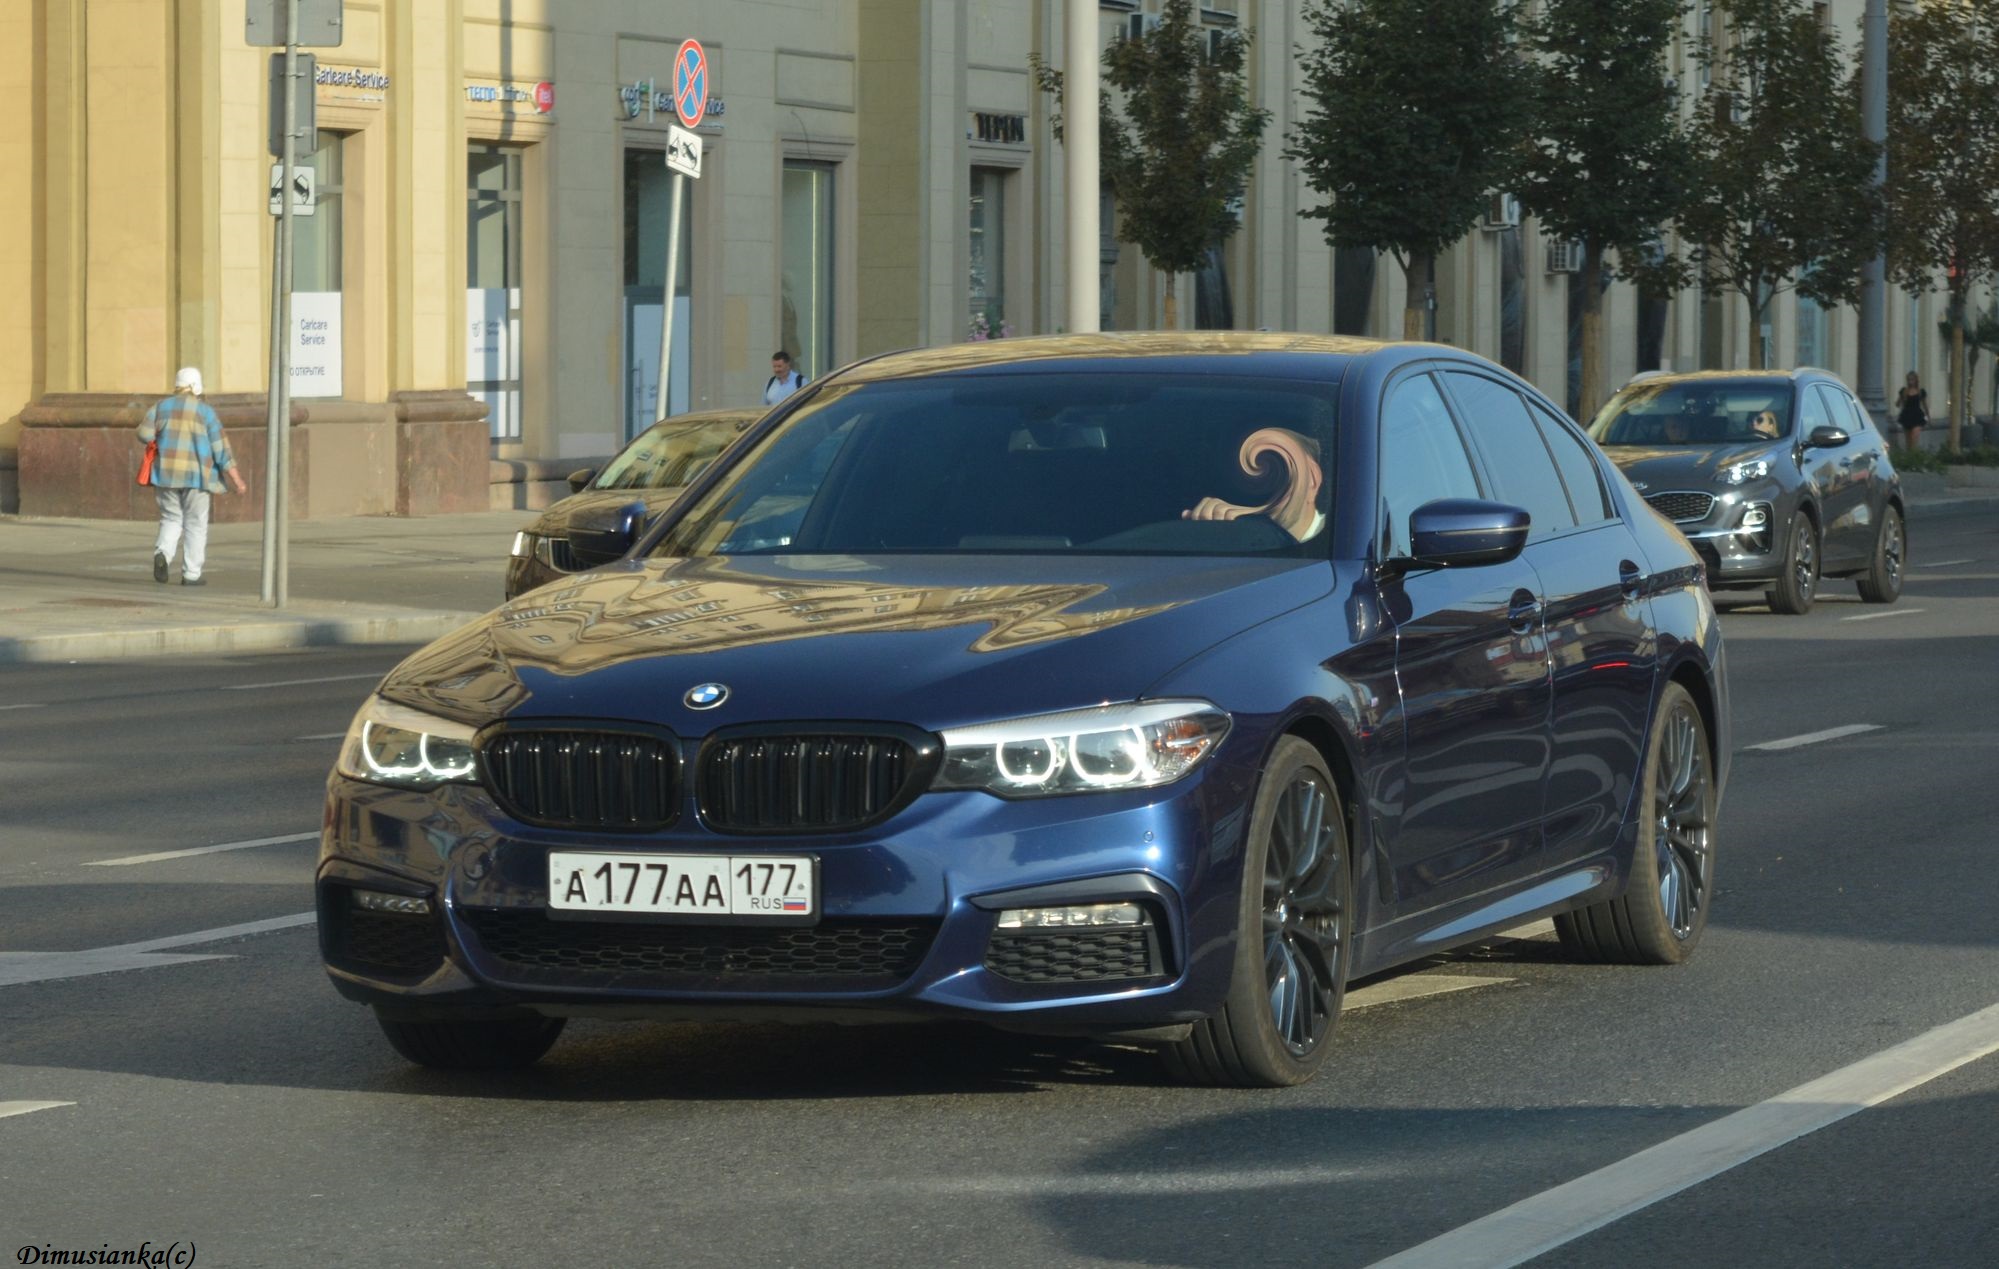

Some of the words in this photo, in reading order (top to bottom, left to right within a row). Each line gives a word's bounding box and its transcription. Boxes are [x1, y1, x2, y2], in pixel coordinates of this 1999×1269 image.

[355, 68, 390, 90] Service
[301, 333, 326, 346] Service
[737, 863, 797, 896] 177
[751, 897, 782, 910] RUS
